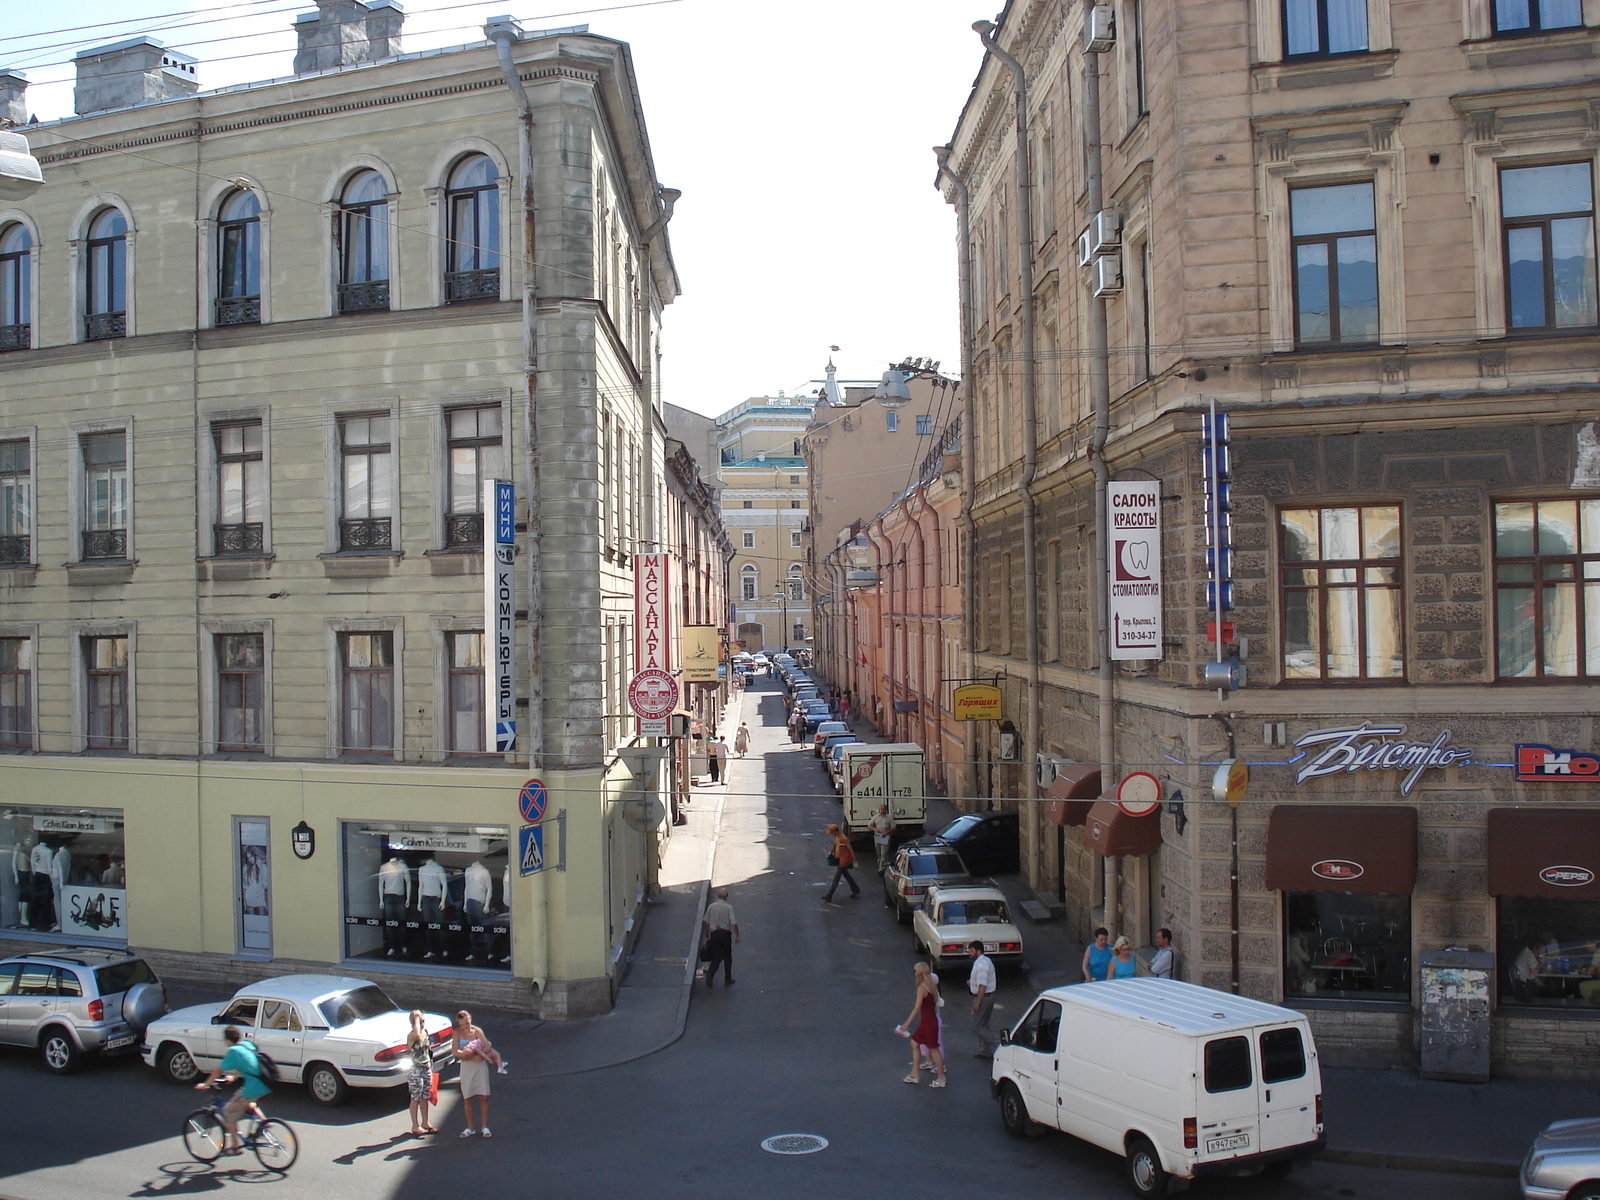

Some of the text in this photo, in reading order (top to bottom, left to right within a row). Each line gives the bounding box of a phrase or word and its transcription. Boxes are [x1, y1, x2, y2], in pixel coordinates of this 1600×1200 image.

[1113, 494, 1156, 507] САЛОН
[501, 488, 511, 538] МИНИ
[1114, 512, 1157, 526] КРАСОТЫ
[1112, 584, 1159, 596] СТОМАТОЛОГИЯ
[644, 555, 660, 668] МАССАНДРА
[1122, 631, 1156, 640] 310-34-37
[499, 573, 512, 718] КОМПЬЮТЕРЫ
[958, 698, 999, 707] Горящих
[1293, 723, 1472, 795] Бистро
[401, 836, 425, 847] Calvin
[445, 838, 467, 849] Jeans
[1556, 871, 1590, 880] PEPSI
[366, 918, 379, 926] sale
[386, 919, 398, 927] sale
[406, 921, 419, 929] sale
[428, 922, 441, 930] sale
[448, 924, 461, 932] sale
[471, 925, 484, 933] sale
[493, 926, 506, 934] sale
